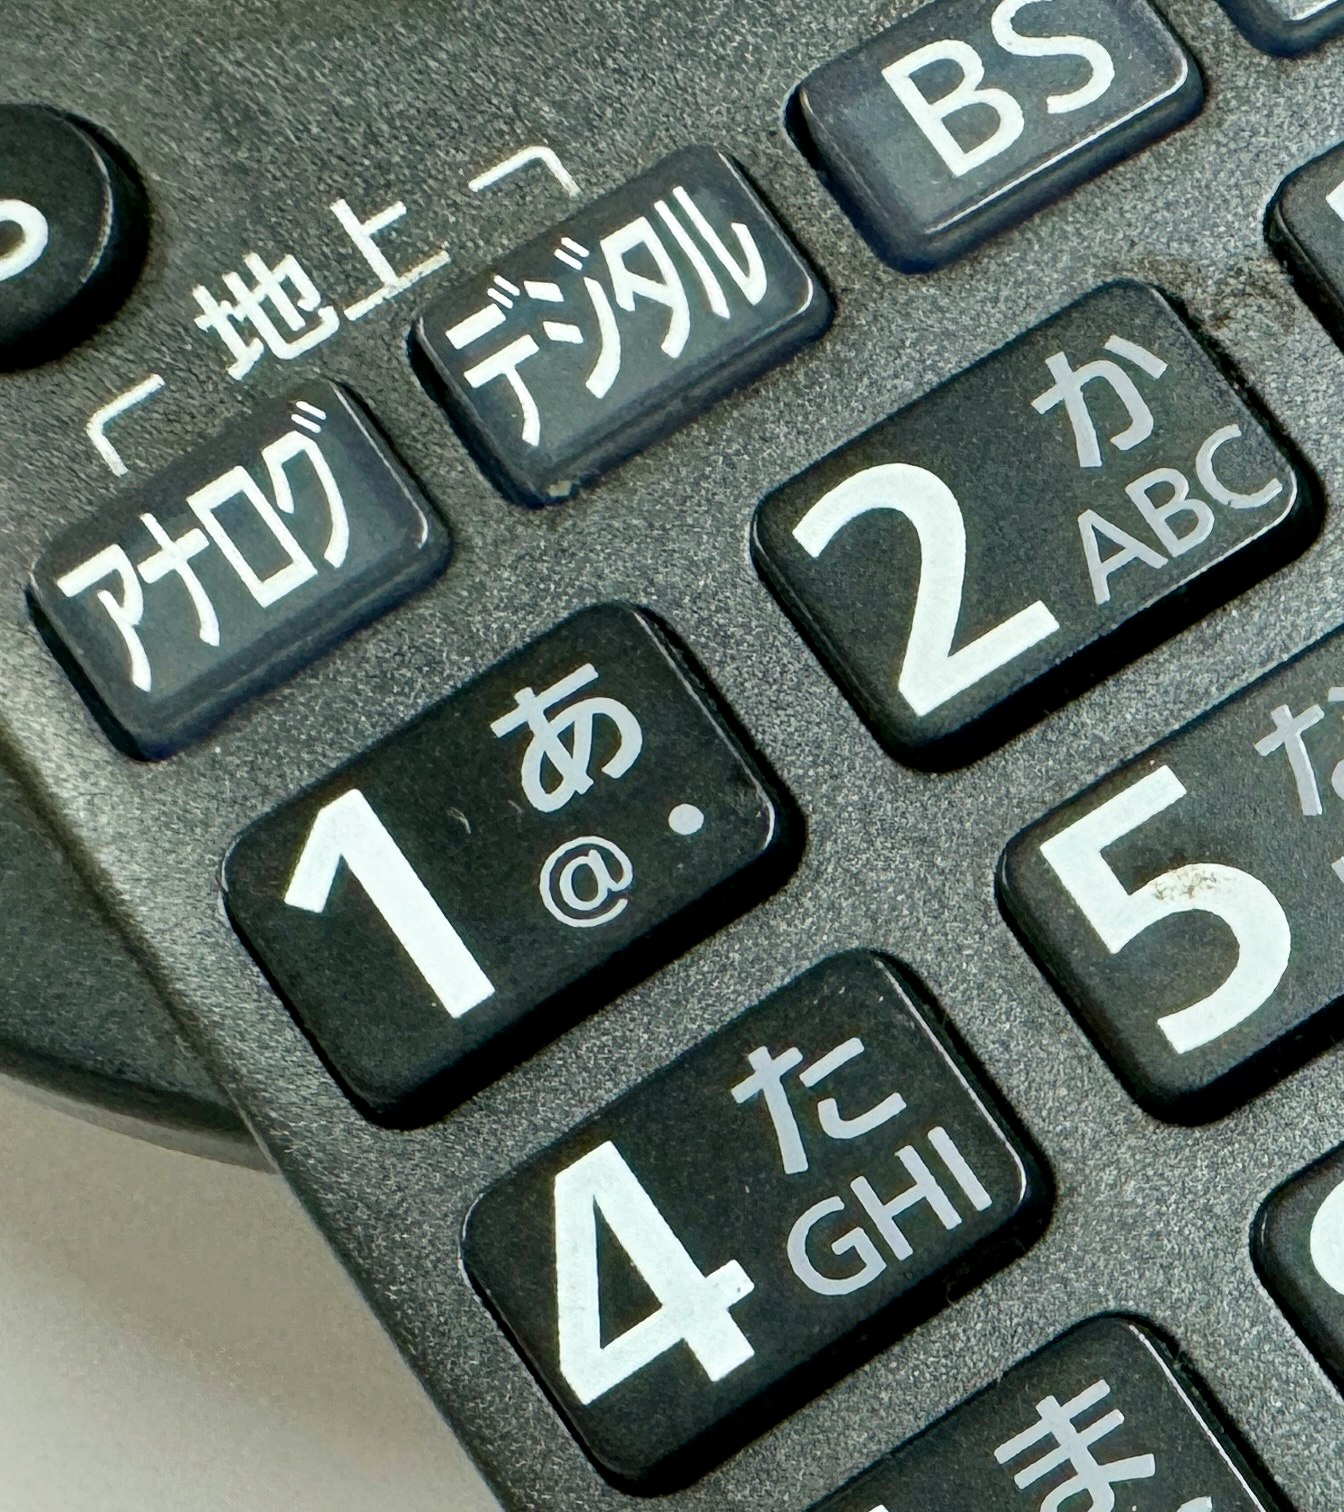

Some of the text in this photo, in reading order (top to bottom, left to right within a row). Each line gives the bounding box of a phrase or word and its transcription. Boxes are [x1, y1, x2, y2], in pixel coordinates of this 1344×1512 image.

[881, 0, 1115, 178] BS
[193, 199, 450, 380] 地上
[445, 186, 768, 447] デジタル
[1031, 335, 1168, 468] か
[56, 402, 350, 693] アナログ
[792, 463, 1060, 717] 2
[1076, 424, 1283, 604] ABC
[491, 663, 643, 812] あ
[283, 788, 496, 1020] 1
[539, 835, 634, 927] @
[1039, 764, 1292, 1055] 5
[731, 1036, 907, 1174] た
[552, 1140, 756, 1406] 4
[786, 1127, 993, 1297] GHI
